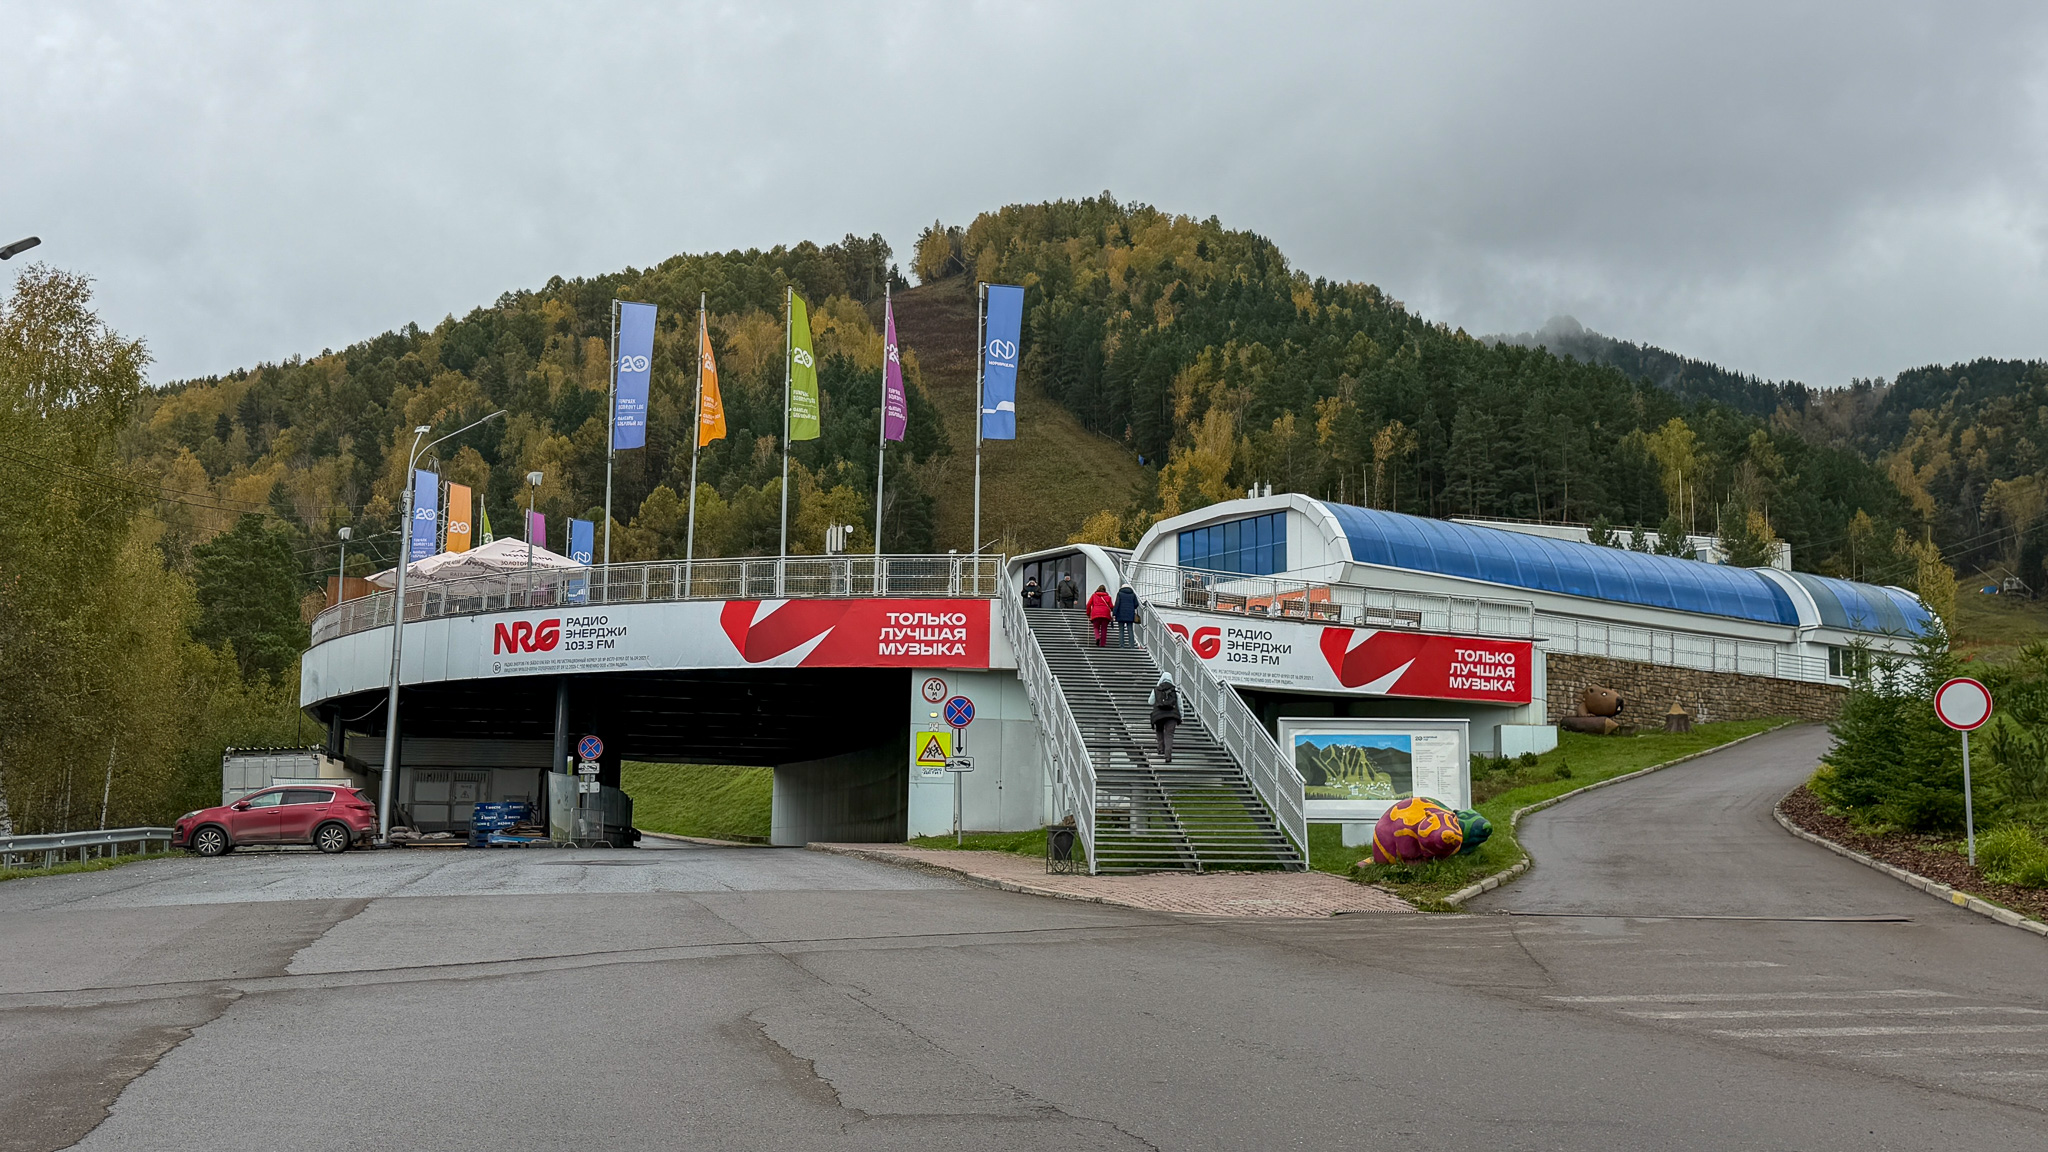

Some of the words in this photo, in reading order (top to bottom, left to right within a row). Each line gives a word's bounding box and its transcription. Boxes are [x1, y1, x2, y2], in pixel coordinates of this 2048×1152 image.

[620, 354, 649, 373] 20
[415, 507, 436, 521] 20
[449, 520, 470, 534] 20
[566, 615, 609, 628] РАДИО
[886, 612, 967, 626] ТОЛЬКО
[493, 618, 561, 655] NRG
[565, 626, 627, 639] ЭНЕРДЖИ
[879, 627, 967, 641] ЛУЧШАЯ
[1227, 628, 1273, 641] РАДИО
[564, 640, 594, 651] 103.3
[596, 639, 615, 649] FM
[1227, 640, 1292, 654] ЭНЕРДЖИ
[1226, 652, 1258, 664] 103.3
[1261, 655, 1280, 666] FM
[1454, 649, 1516, 665] ТОЛЬКО
[1449, 662, 1515, 678] ЛУЧШАЯ
[928, 682, 942, 692] 4,0
